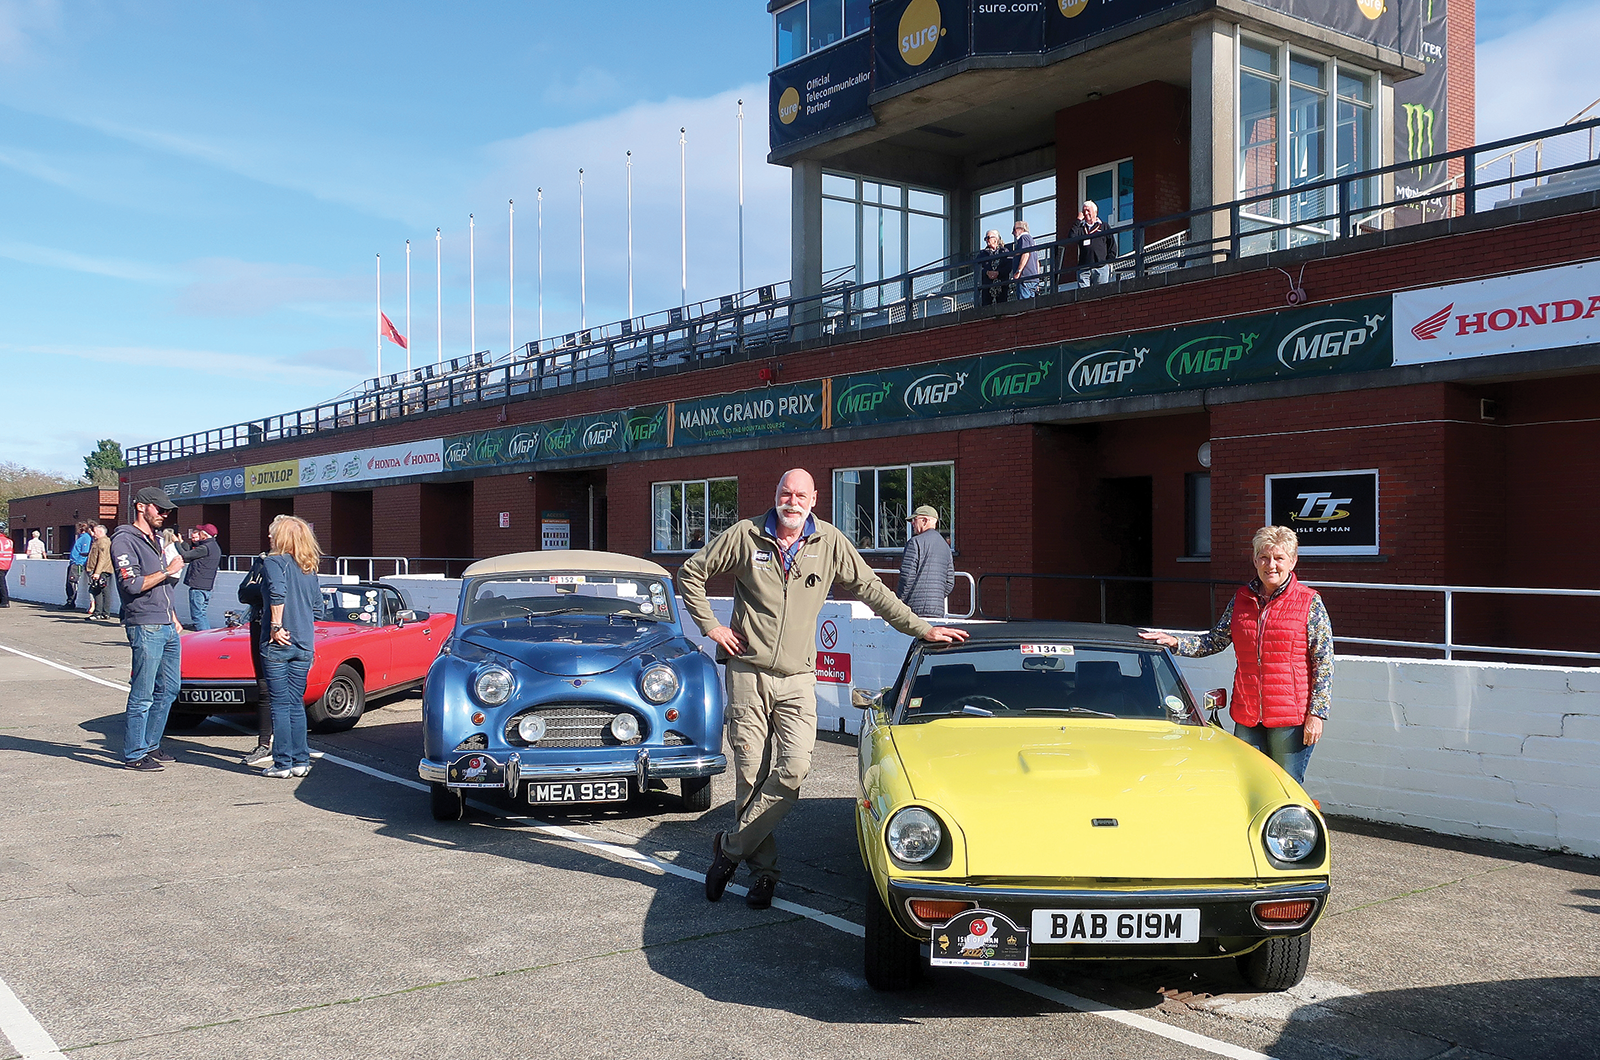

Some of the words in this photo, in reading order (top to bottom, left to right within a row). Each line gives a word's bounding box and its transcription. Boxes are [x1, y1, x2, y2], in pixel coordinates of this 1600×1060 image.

[979, 3, 1039, 13] sure.com
[806, 73, 830, 91] Official
[806, 99, 831, 115] Partner
[1291, 327, 1368, 362] MGP
[1178, 344, 1244, 375] MGP
[1078, 358, 1136, 387] MGP
[991, 371, 1042, 397] MGP
[844, 391, 885, 414] MGP
[912, 381, 959, 406] MGP
[680, 406, 720, 429] MANX
[723, 399, 775, 423] GRAND
[778, 393, 815, 417] PRIX
[587, 428, 613, 446] MGP
[628, 423, 658, 441] MGP
[447, 448, 467, 463] MGP
[512, 439, 535, 455] MGP
[374, 457, 401, 469] HONDA
[411, 452, 441, 465] HONDA
[257, 468, 293, 485] DUNLOP
[1296, 491, 1353, 523] TT
[1037, 645, 1057, 653] 134
[823, 655, 835, 666] No
[814, 666, 845, 681] smoking
[182, 690, 208, 702] TGU
[211, 690, 241, 702] 120L
[536, 784, 575, 802] MEA
[580, 782, 620, 800] 933
[1051, 913, 1108, 939] BAB
[1116, 913, 1182, 939] 619M
